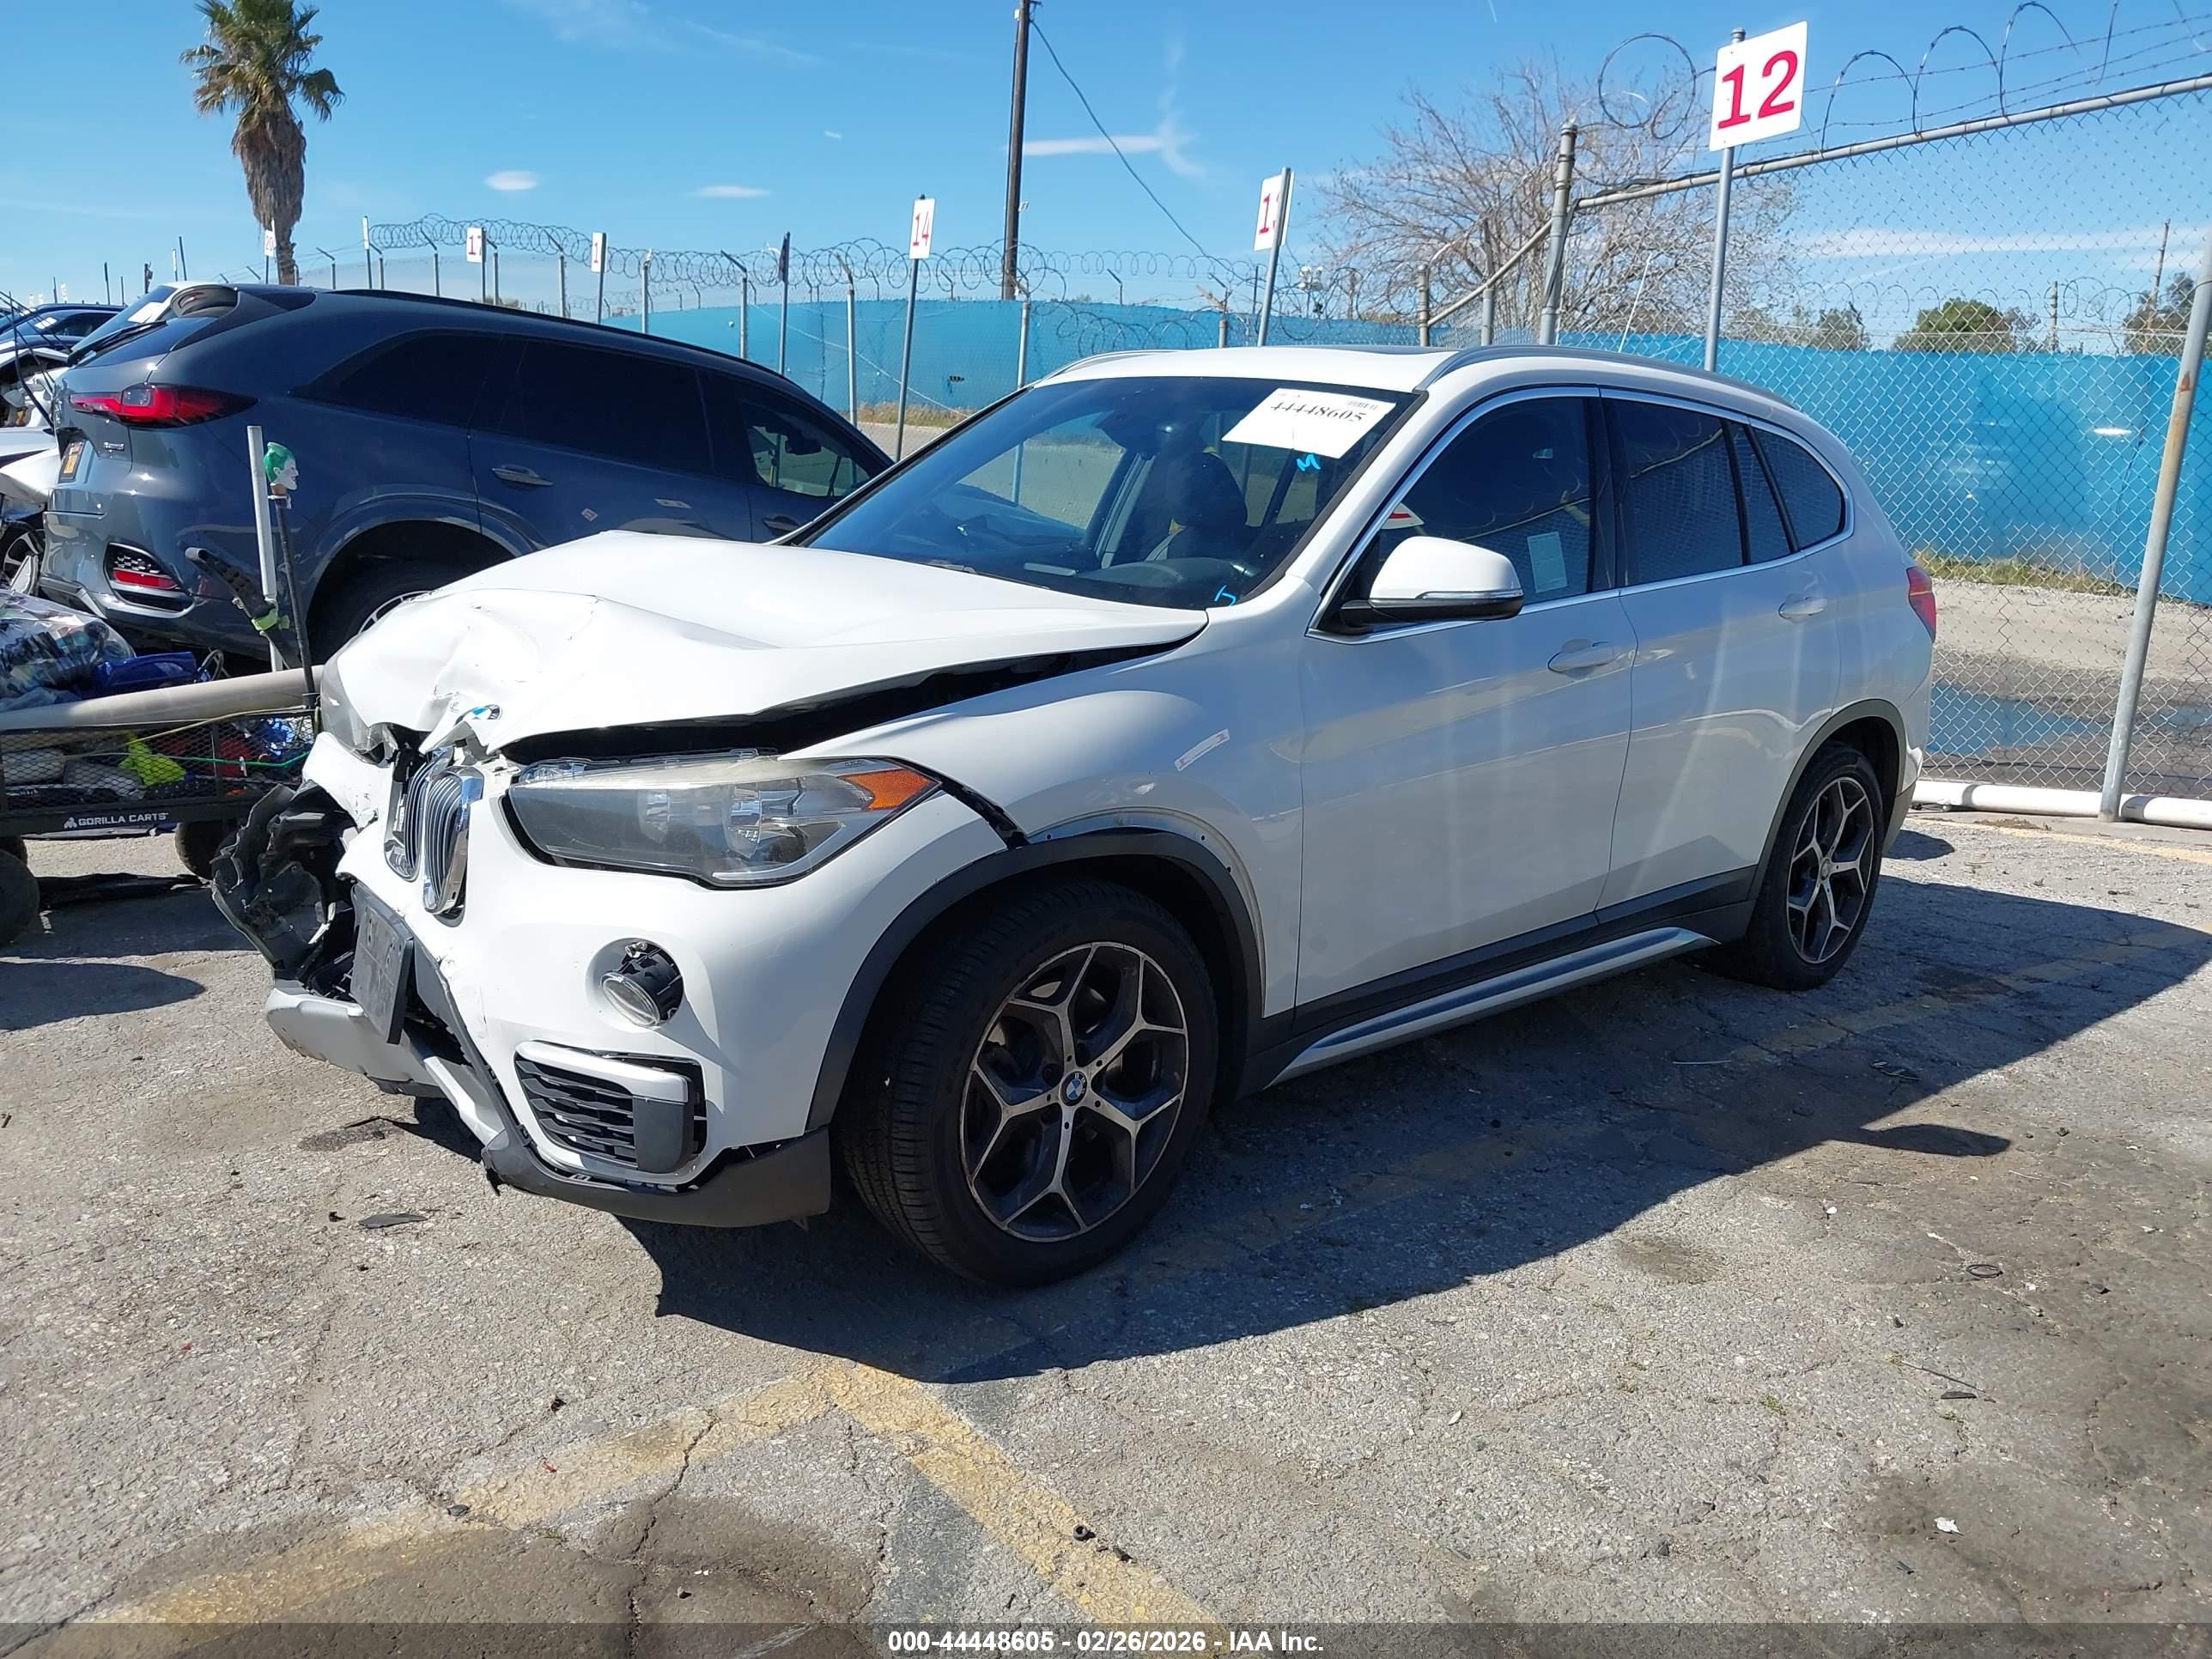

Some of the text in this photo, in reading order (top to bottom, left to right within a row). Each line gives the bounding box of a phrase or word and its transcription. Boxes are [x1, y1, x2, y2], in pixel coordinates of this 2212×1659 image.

[1717, 50, 1798, 130] 12
[913, 210, 930, 247] 14
[1271, 401, 1367, 422] 44448605
[78, 812, 167, 826] GORILLA CARTS
